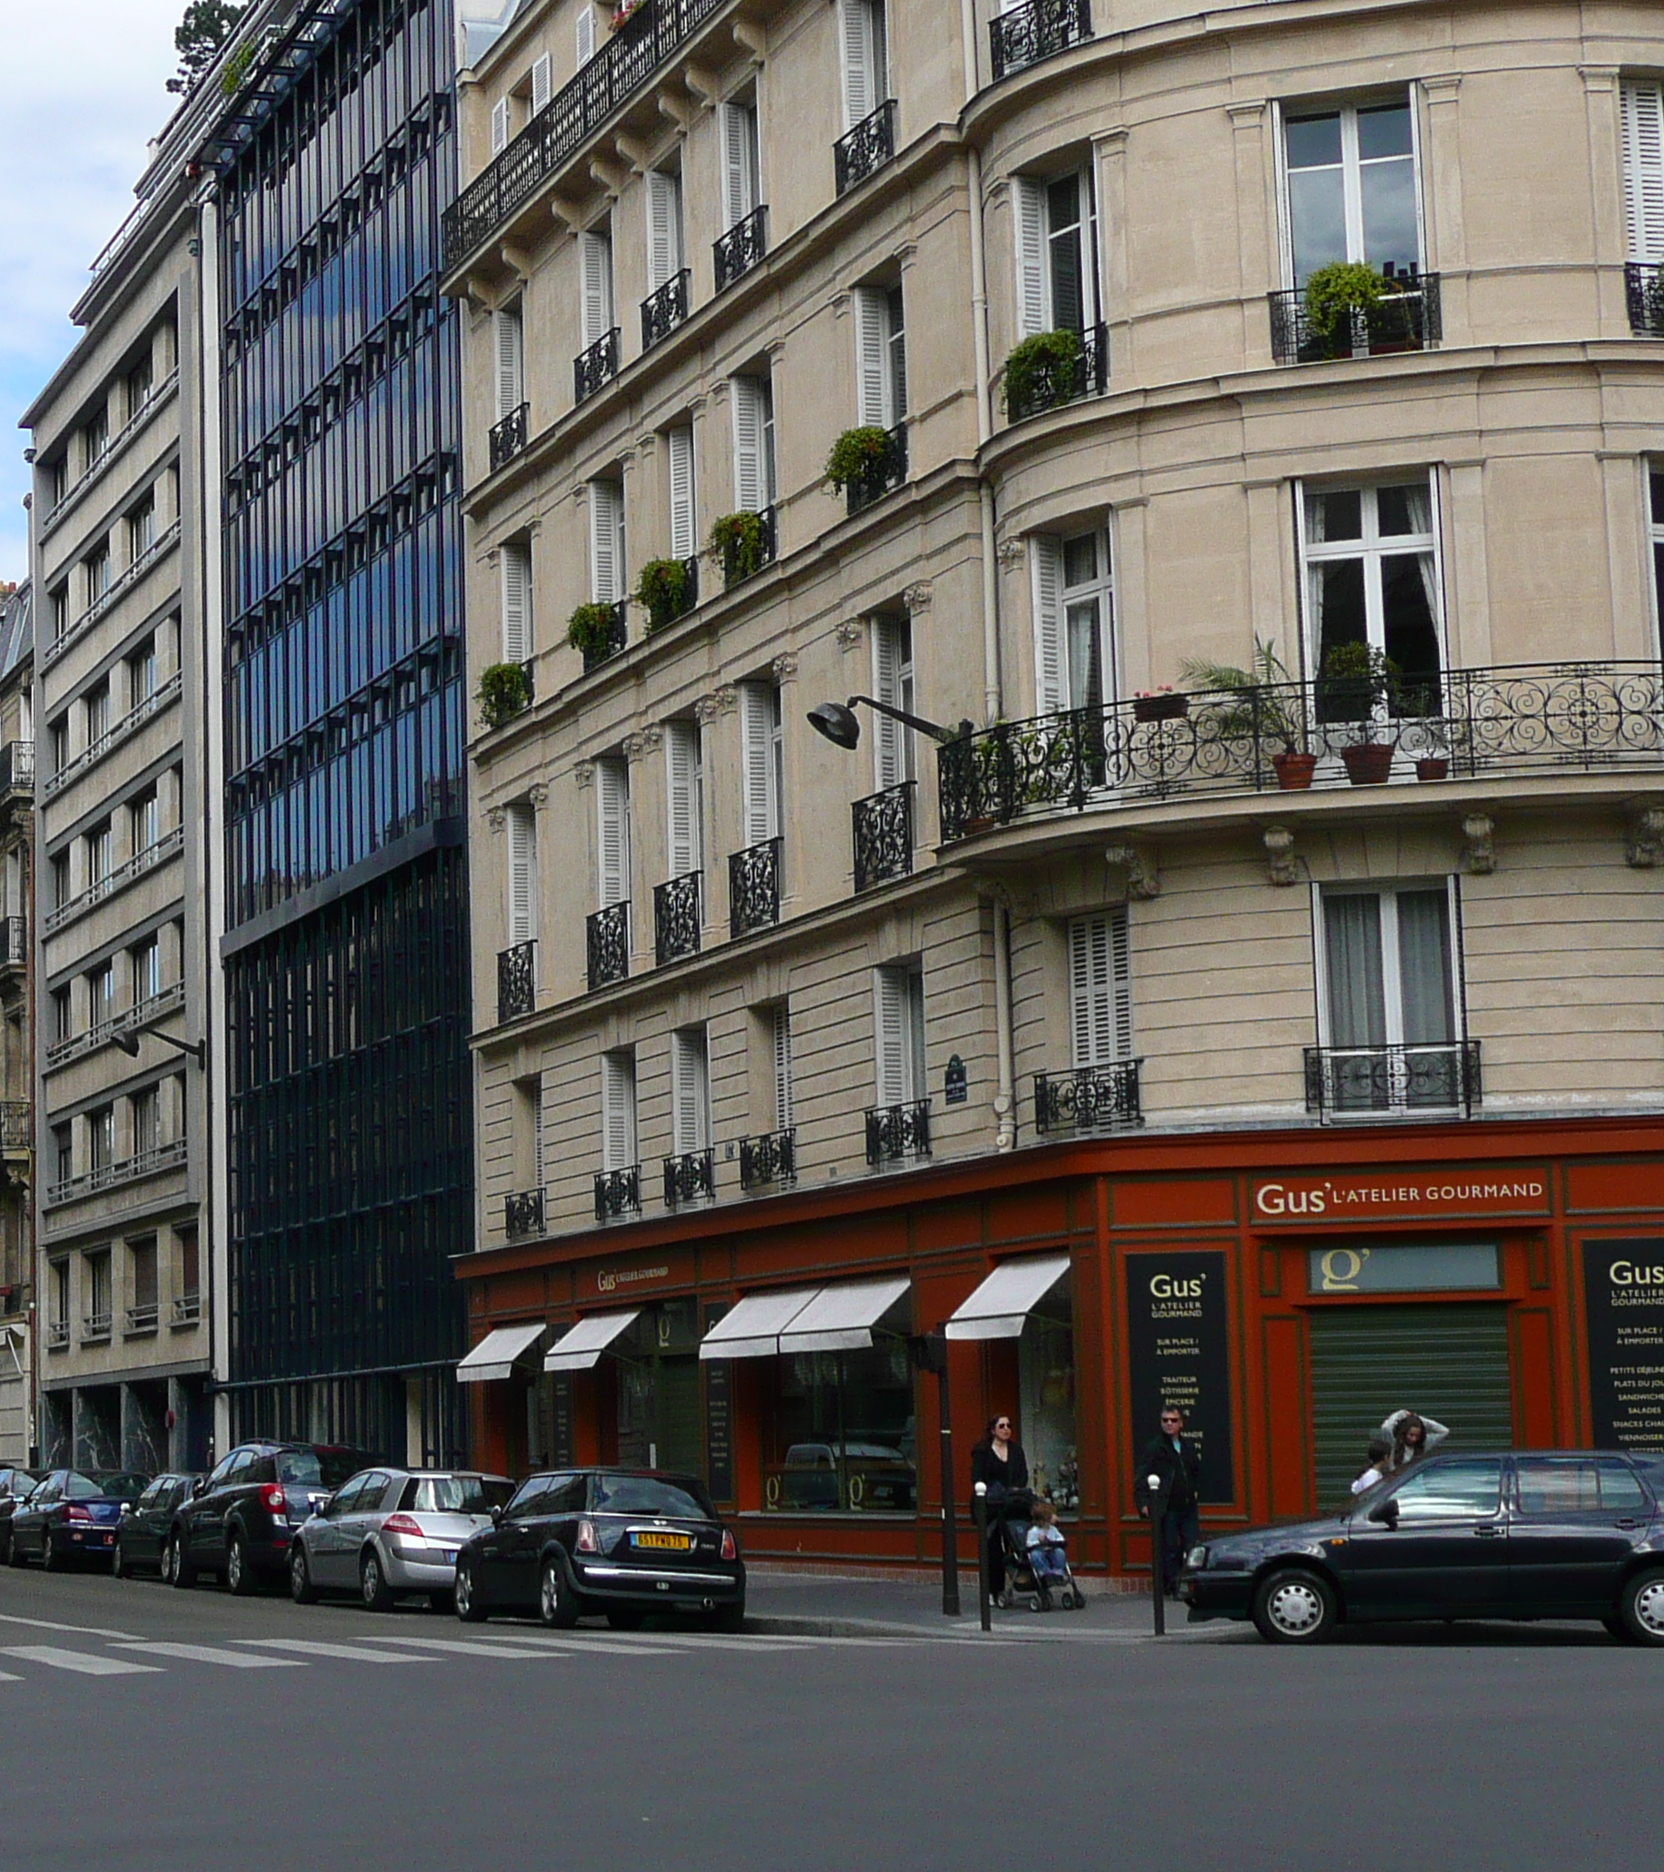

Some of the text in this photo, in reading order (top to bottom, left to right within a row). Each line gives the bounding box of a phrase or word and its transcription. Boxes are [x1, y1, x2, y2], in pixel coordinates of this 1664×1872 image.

[1257, 1182, 1543, 1214] Gus' L'ATELIER GOURMAND
[1150, 1273, 1207, 1297] Gus'
[1151, 1302, 1202, 1310] L'ATELIER
[1151, 1310, 1203, 1318] GOURMAND
[1172, 1337, 1194, 1345] PLACE
[1614, 1380, 1635, 1388] PLATS
